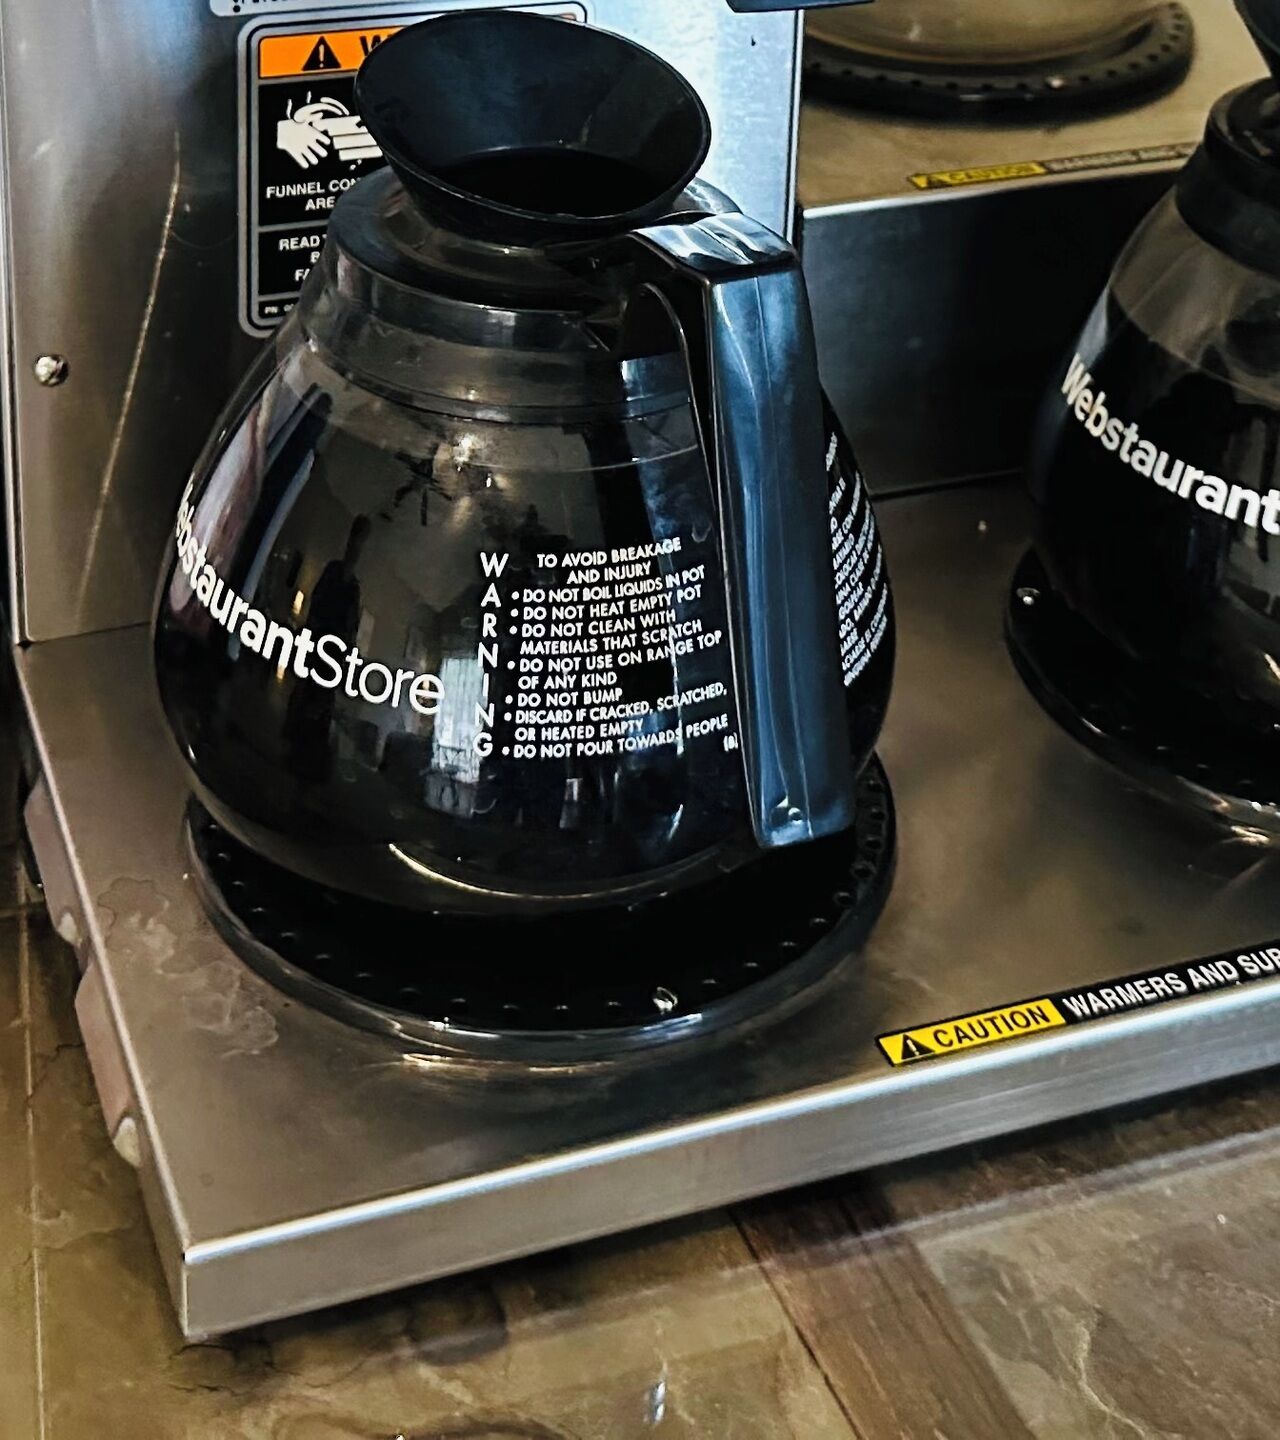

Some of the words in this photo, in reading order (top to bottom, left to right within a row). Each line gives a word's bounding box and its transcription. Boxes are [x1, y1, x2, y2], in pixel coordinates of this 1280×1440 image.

[265, 181, 325, 199] FUNNEL
[328, 177, 361, 192] CO
[305, 196, 336, 211] ARE
[279, 235, 321, 251] READ
[537, 553, 557, 568] TO
[561, 551, 608, 568] AVOID
[611, 537, 682, 564] BREAKAGE
[523, 589, 546, 603] DO
[548, 588, 580, 603] NOT
[582, 586, 612, 601] BOIL
[614, 576, 663, 599] LIQUIDS
[665, 573, 680, 589] IN
[682, 564, 705, 585] POT
[566, 567, 601, 585] AND
[604, 561, 652, 582] INJURY
[523, 607, 547, 621] DO
[551, 605, 584, 621] NOT
[589, 600, 625, 618] HEAT
[629, 591, 673, 613] EMPTY
[676, 584, 702, 602] POT
[519, 638, 598, 655] MATERIALS
[602, 633, 637, 652] THAT
[641, 619, 703, 644] SCRATCH
[521, 623, 546, 638] DO
[550, 622, 583, 637] NOT
[588, 616, 636, 635] CLEAN
[640, 608, 676, 629] WITH
[473, 551, 510, 757] WARNING
[519, 658, 543, 673] DO
[547, 656, 580, 673] NOT
[585, 653, 613, 671] USE
[617, 649, 643, 667] ON
[646, 641, 694, 662] RANGE
[696, 630, 722, 651] TOP
[517, 676, 539, 690] OF
[543, 674, 577, 690] ANY
[581, 671, 618, 687] KIND
[515, 710, 573, 725] DISCARD
[575, 708, 587, 721] IF
[589, 701, 653, 721] CRACKED,
[656, 681, 728, 712] SCRATCHED,
[517, 692, 541, 707] DO
[546, 691, 577, 707] NOT
[583, 687, 623, 705] BUMP
[513, 744, 536, 759] DO
[540, 742, 572, 759] NOT
[576, 739, 613, 757] POUR
[617, 727, 682, 751] TOWARDS
[686, 713, 729, 739] PEOPLE
[514, 727, 536, 742] OR
[541, 723, 595, 741] HEATED
[599, 717, 644, 738] EMPTY
[931, 1006, 1051, 1051] CAUTION
[1062, 970, 1187, 1019] WARMERS
[1190, 959, 1239, 993] AND
